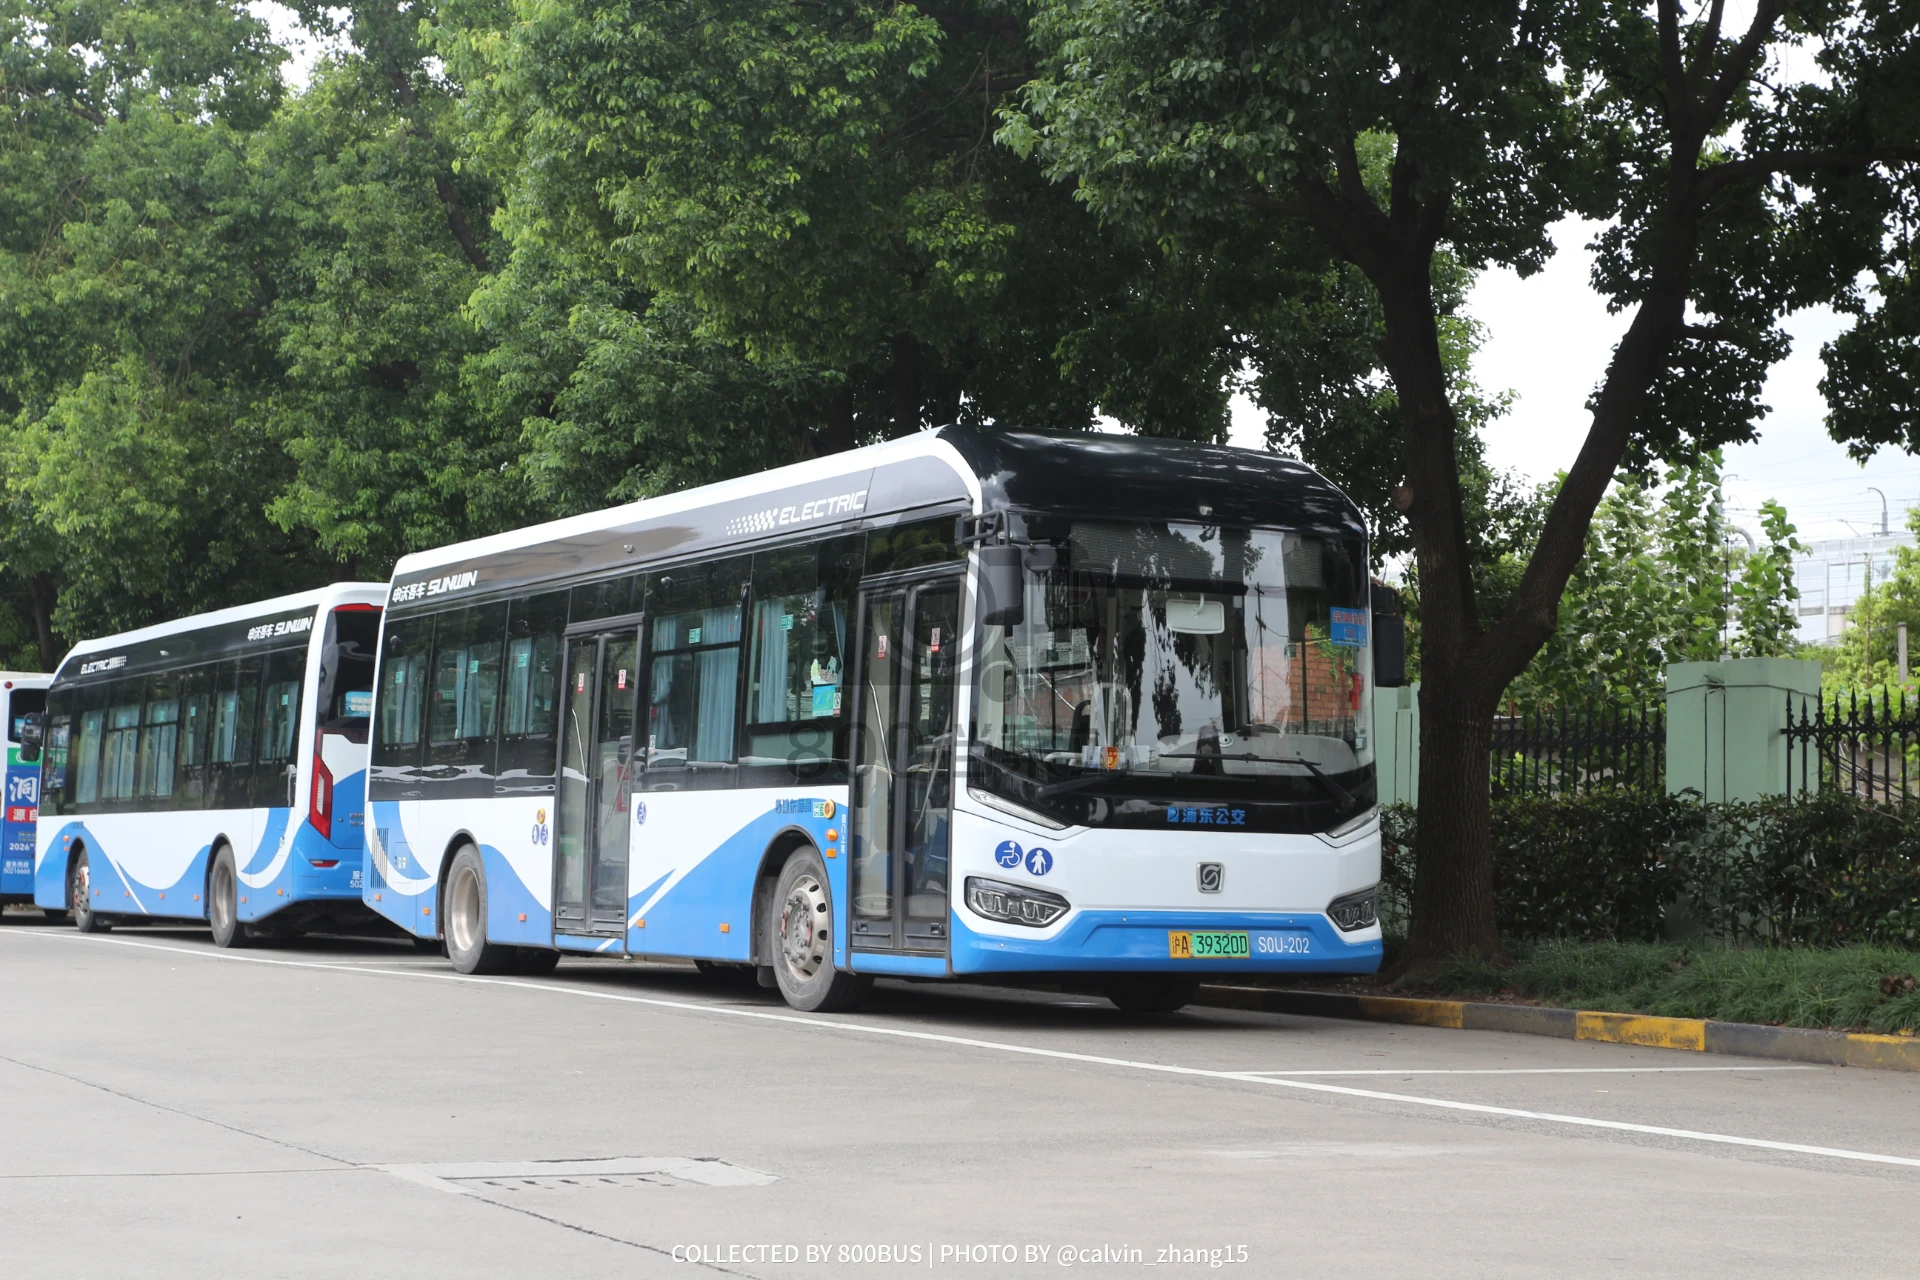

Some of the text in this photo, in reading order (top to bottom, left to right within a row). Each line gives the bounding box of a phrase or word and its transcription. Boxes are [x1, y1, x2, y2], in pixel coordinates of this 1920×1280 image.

[778, 490, 868, 525] ELECTRIC
[392, 570, 478, 603] 申沃客车 SUNWIN
[273, 616, 313, 637] SUNWIN
[1182, 807, 1246, 825] 浦东公交
[9, 842, 30, 851] 2026
[1171, 935, 1248, 954] 沪A 39320D
